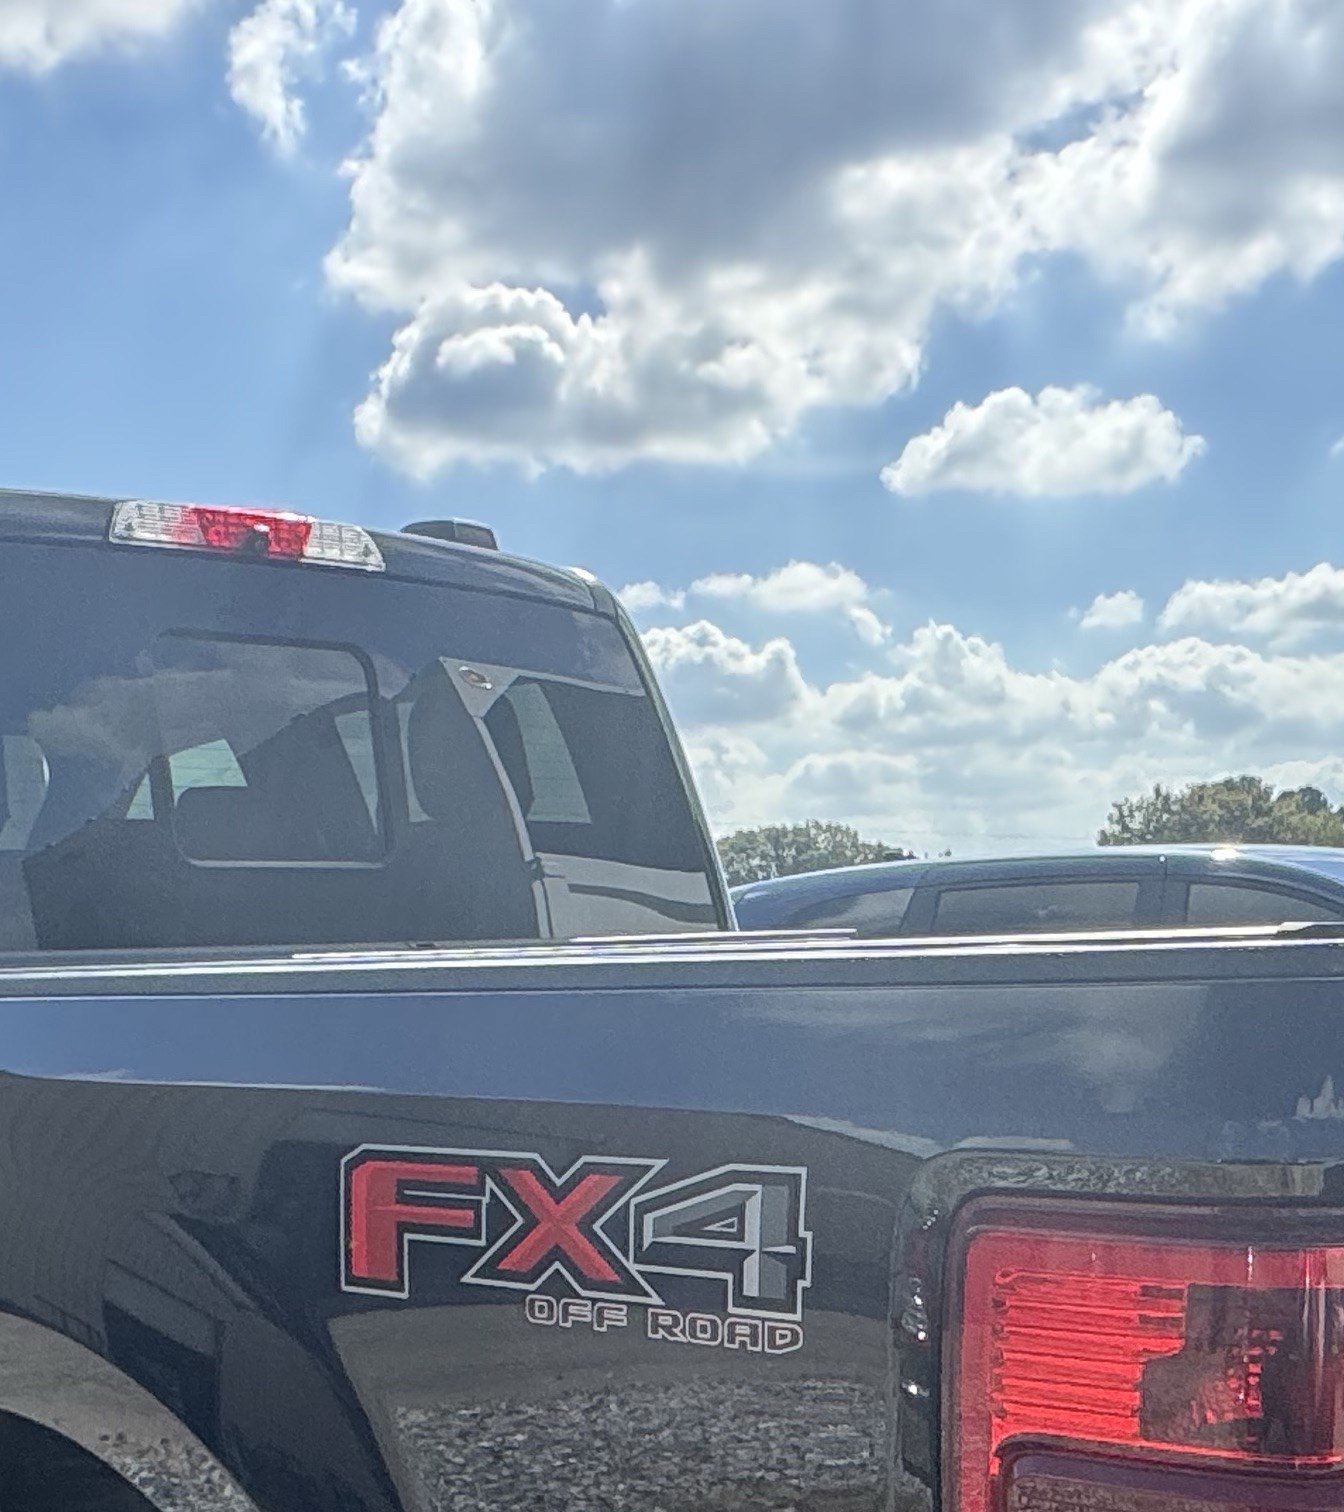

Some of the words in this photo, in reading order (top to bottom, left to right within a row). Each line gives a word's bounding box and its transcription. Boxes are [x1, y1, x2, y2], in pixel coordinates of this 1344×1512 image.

[340, 1143, 813, 1321] FX4
[524, 1294, 628, 1332] OFF
[647, 1308, 804, 1354] ROAD
